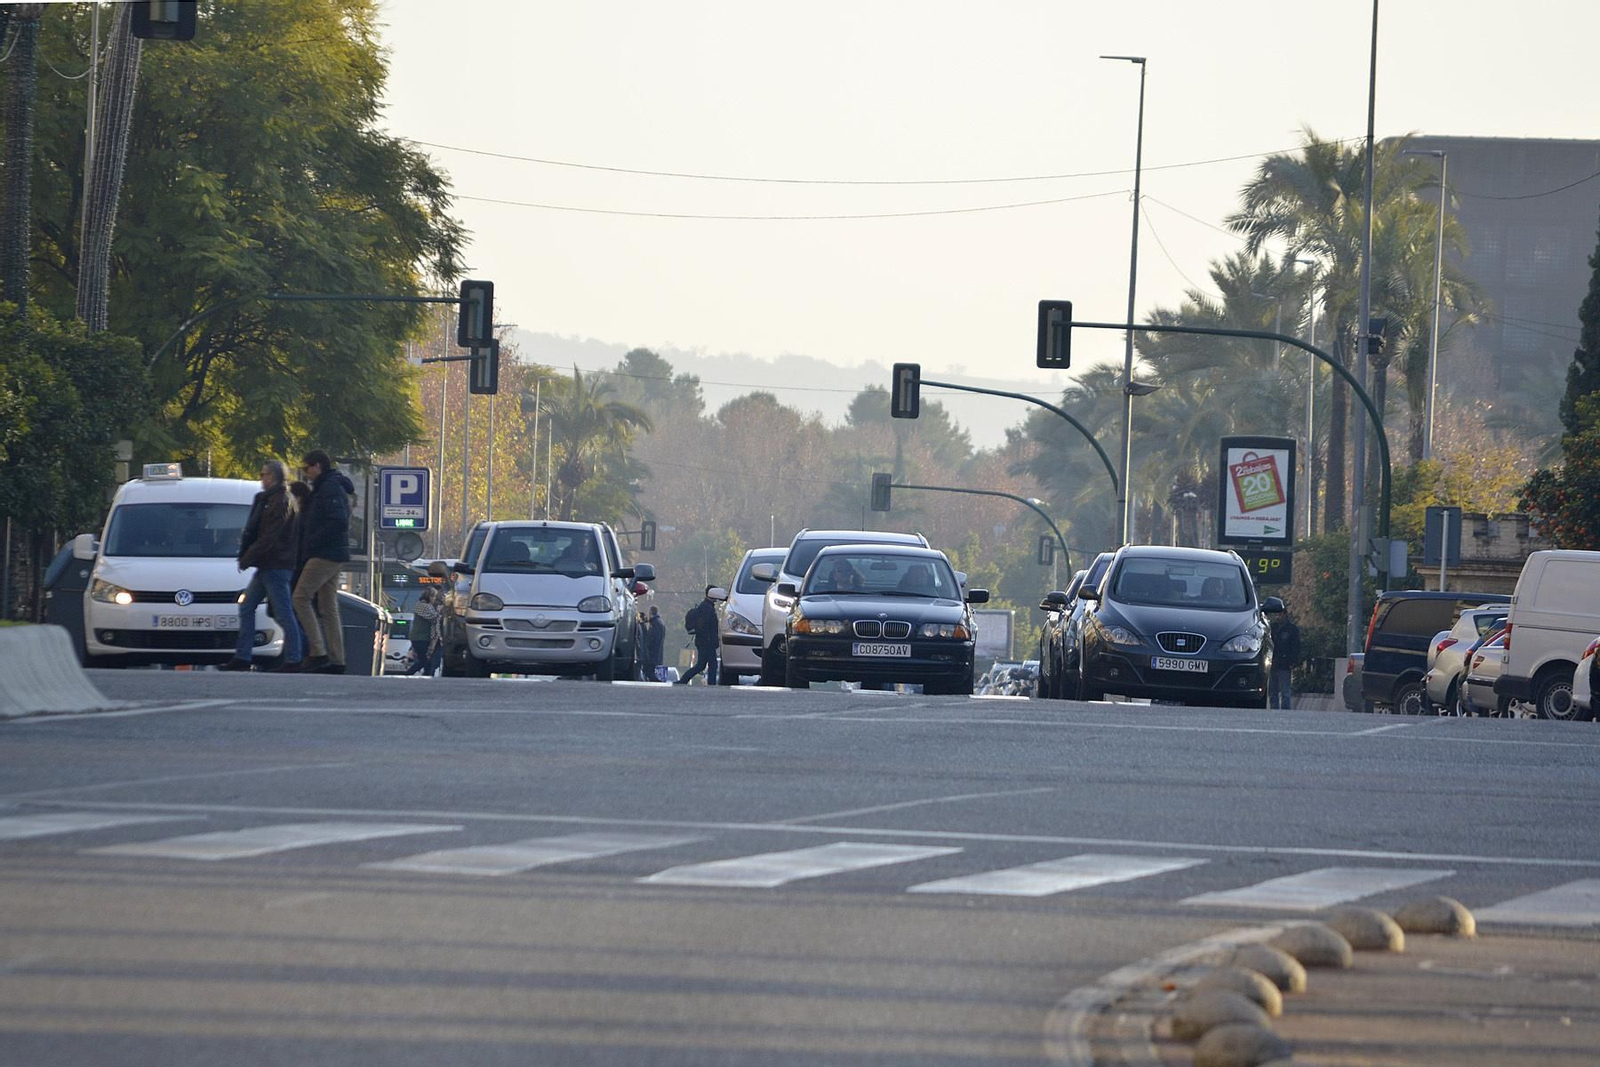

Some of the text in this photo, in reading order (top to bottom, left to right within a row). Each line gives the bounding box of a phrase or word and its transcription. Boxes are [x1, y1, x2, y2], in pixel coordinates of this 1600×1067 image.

[390, 474, 418, 504] P
[1245, 473, 1271, 496] 20
[395, 519, 415, 527] LIBRE
[160, 617, 188, 627] 8800
[192, 617, 211, 627] HPS
[1158, 658, 1207, 671] 5990 GMV
